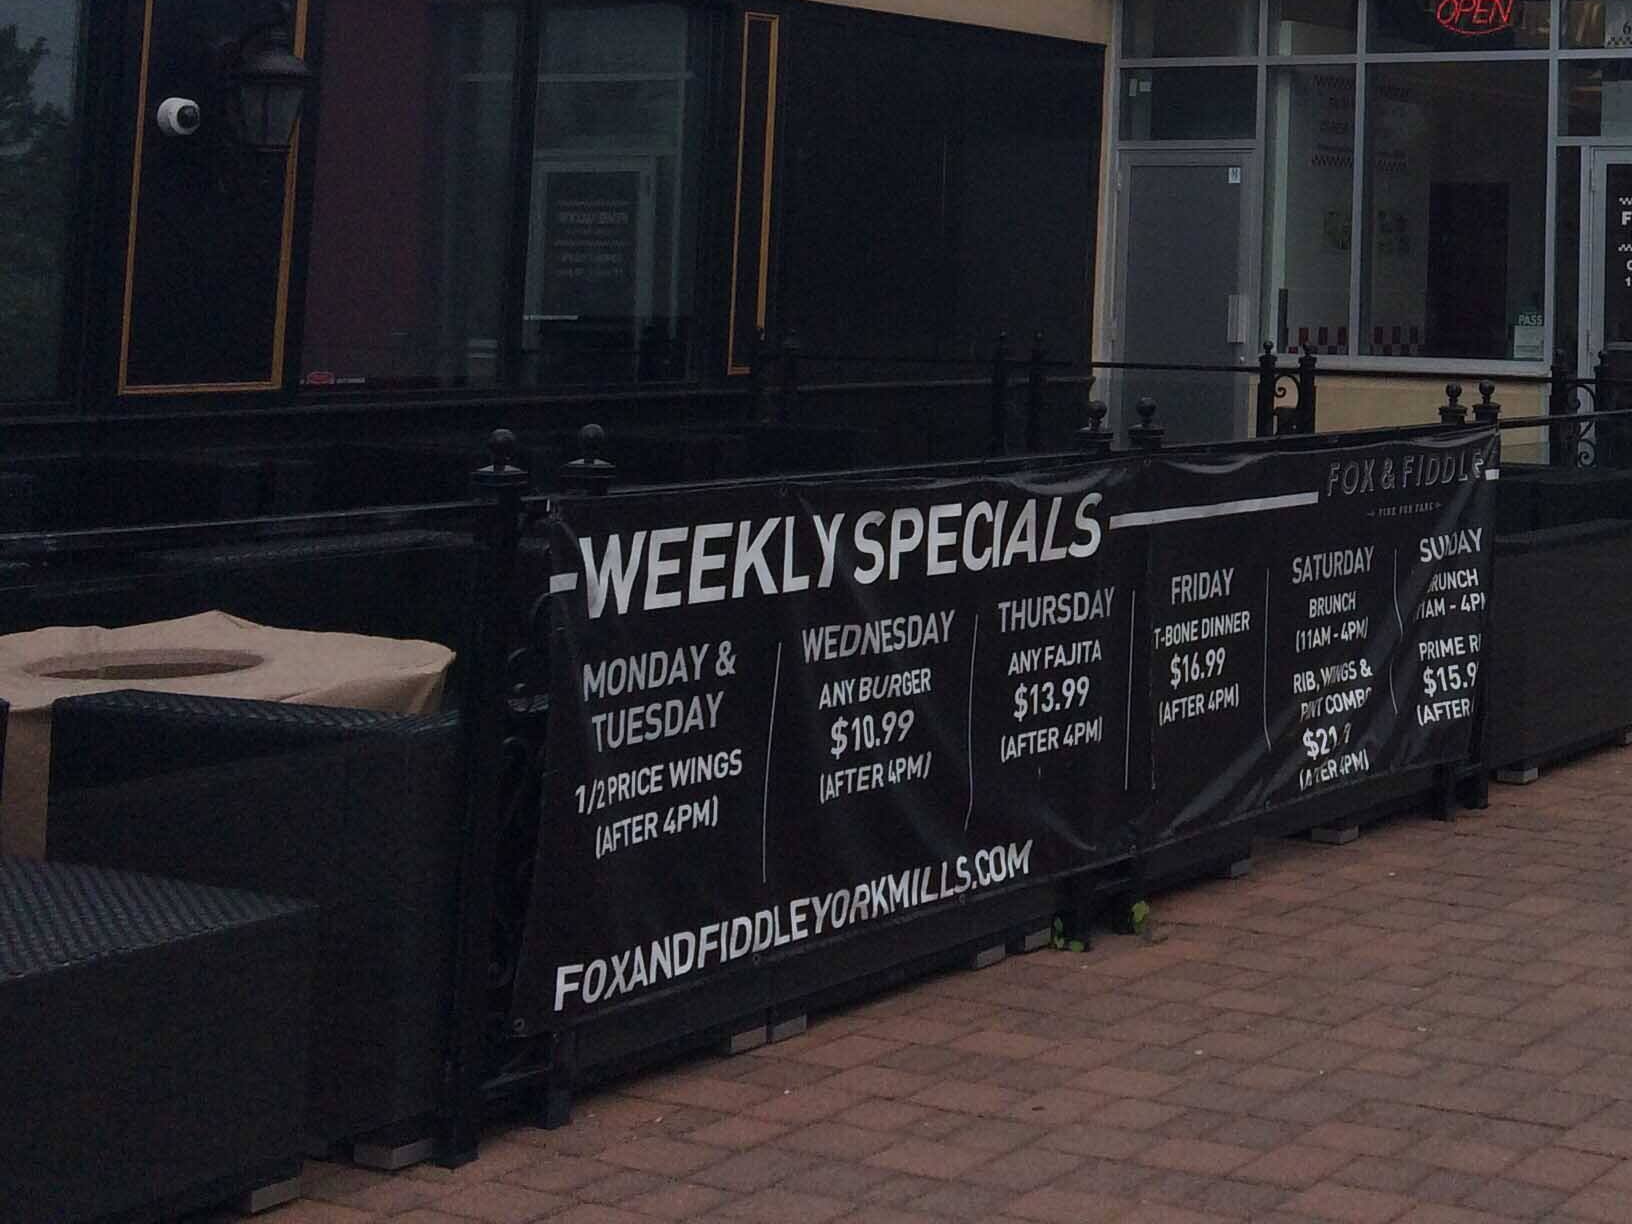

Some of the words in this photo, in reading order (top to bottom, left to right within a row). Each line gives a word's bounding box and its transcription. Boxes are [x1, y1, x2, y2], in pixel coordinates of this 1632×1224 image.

[1519, 314, 1543, 326] PASS
[1327, 458, 1376, 497] FOX
[1382, 457, 1396, 490] &
[578, 512, 845, 620] WEEKLY
[853, 492, 1103, 585] SPECIALS
[1292, 545, 1375, 584] SATURDAY
[1171, 567, 1234, 605] FRIDAY
[1309, 590, 1356, 618] BRUNCH
[998, 586, 1115, 633] THURSDAY
[1153, 619, 1199, 650] T-BONE
[1201, 610, 1250, 640] DINNER
[801, 609, 955, 664] WEDNESDAY
[1295, 625, 1332, 654] (11AM
[1341, 615, 1369, 641] 4PM)
[1418, 636, 1466, 662] PRIME
[583, 642, 711, 702] MONDAY
[715, 640, 737, 677] &
[1007, 647, 1042, 676] ANY
[1044, 639, 1102, 670] FAJITA
[1170, 647, 1226, 690] $16.99
[1293, 670, 1320, 694] RIB,
[1360, 658, 1374, 678] &
[818, 678, 856, 710] ANY
[858, 667, 932, 702] BURGER
[1013, 676, 1090, 722] $13.99
[1423, 661, 1479, 698] $15.9
[591, 690, 724, 753] TUESDAY
[1159, 693, 1205, 726] (AFTER
[1207, 682, 1240, 712] 4PM)
[1416, 697, 1470, 726] (AFTER
[831, 709, 915, 760] $10.99
[1000, 726, 1060, 764] (AFTER
[1063, 716, 1103, 747] 4PM)
[575, 779, 605, 815] 1/2
[608, 764, 664, 805] PRICE
[669, 748, 743, 789] WINGS
[819, 762, 884, 805] (AFTER
[888, 751, 933, 785] 4PM)
[595, 811, 658, 859] (AFTER
[663, 794, 719, 834] 4PM)
[553, 839, 1033, 1012] FOXANDFIDDLEYORKMILLS.COM
